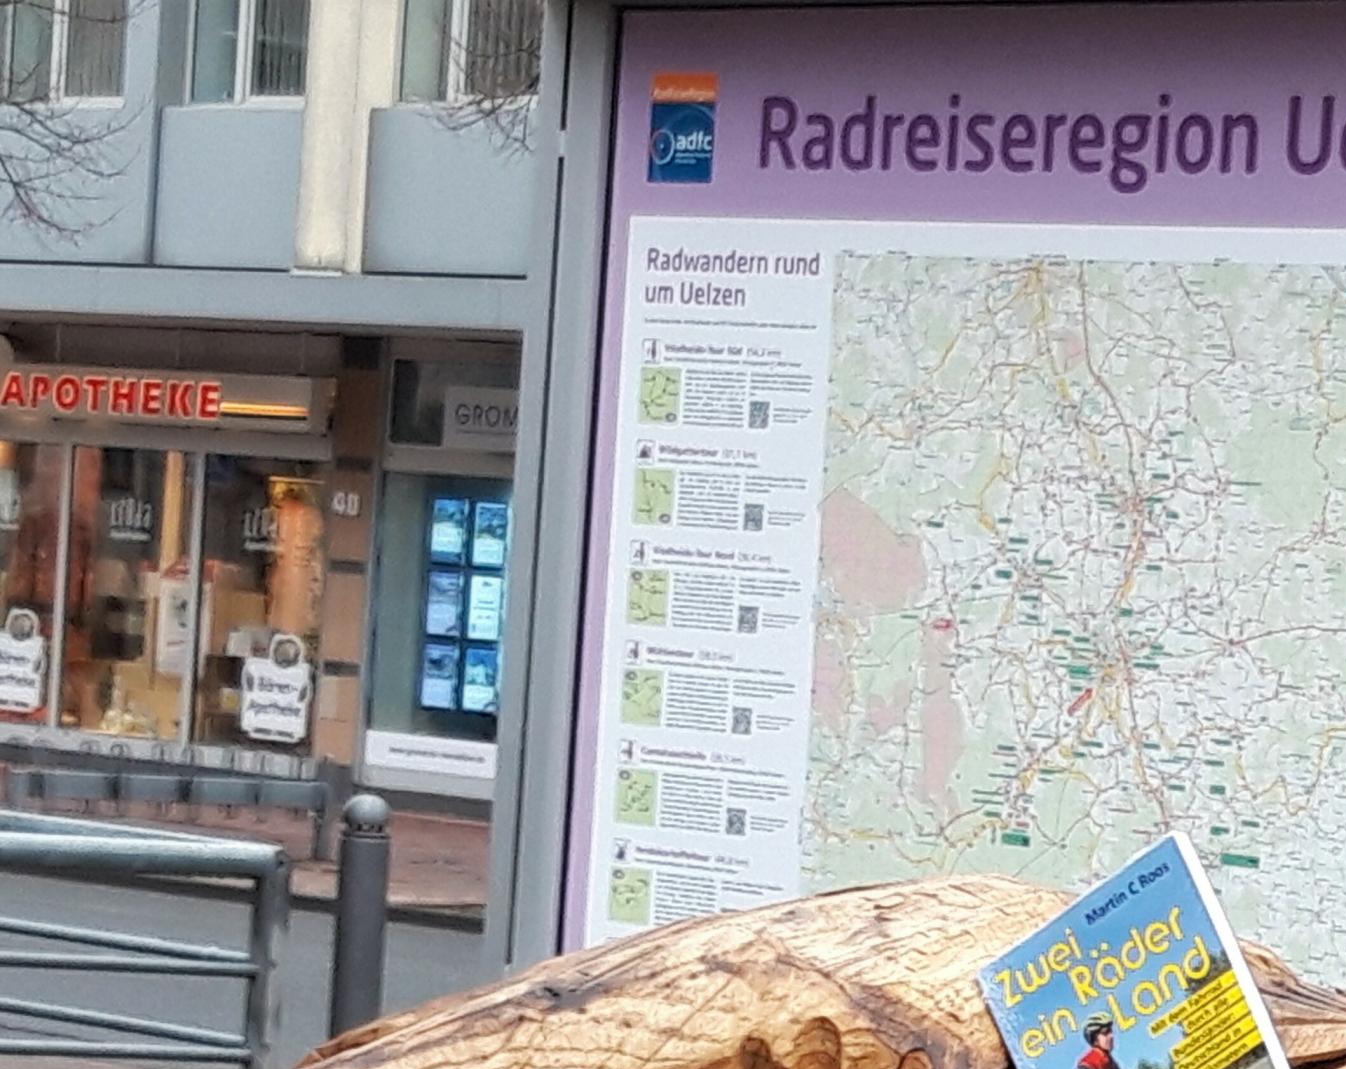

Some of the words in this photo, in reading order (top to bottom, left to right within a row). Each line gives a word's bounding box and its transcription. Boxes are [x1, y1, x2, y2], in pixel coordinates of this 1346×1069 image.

[676, 131, 713, 151] adfc
[758, 93, 1259, 194] Radreiseregion
[646, 247, 769, 275] Radwandern
[774, 252, 821, 277] rund
[645, 284, 674, 305] um
[679, 281, 746, 307] Uelzen
[0, 370, 222, 421] APOTHEKE
[331, 490, 361, 517] 40
[1083, 890, 1128, 925] Martin
[1127, 881, 1140, 895] C
[1139, 862, 1171, 889] Roos
[993, 927, 1082, 1008] Zwei
[1069, 905, 1184, 1006] Räder
[1107, 936, 1212, 1031] Land
[1020, 1008, 1078, 1058] ein
